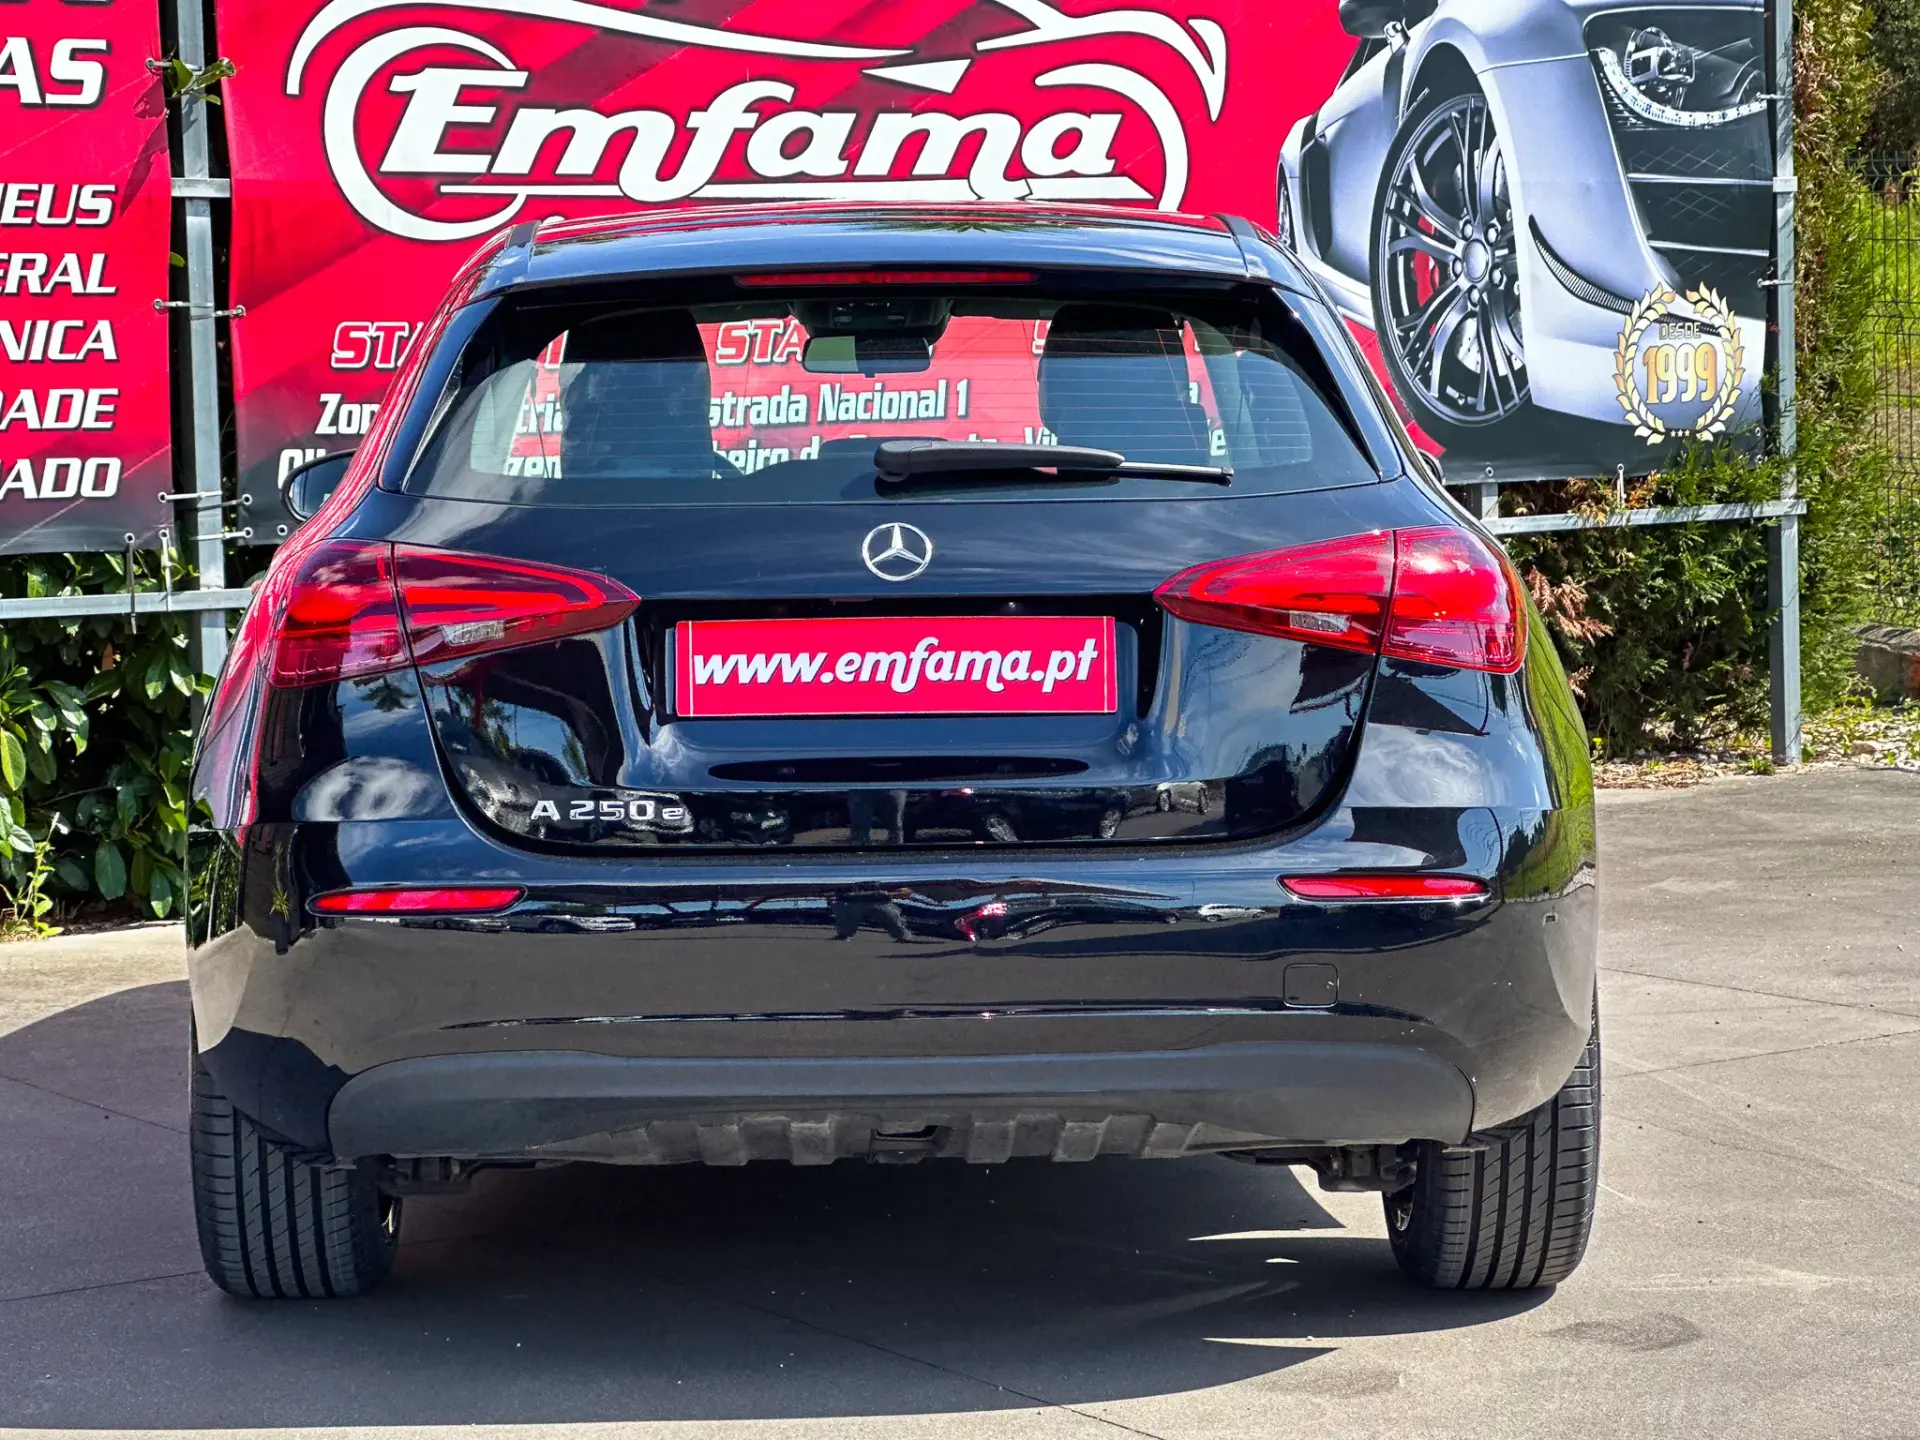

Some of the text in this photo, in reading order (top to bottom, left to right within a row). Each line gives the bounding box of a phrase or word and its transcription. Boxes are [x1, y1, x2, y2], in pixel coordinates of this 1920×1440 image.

[379, 67, 1125, 201] Emfama
[0, 182, 117, 226] EUS
[715, 319, 803, 364] STA
[1659, 322, 1702, 340] DESDE
[1642, 342, 1718, 404] 1999
[0, 387, 120, 430] ADE
[709, 384, 809, 427] strada
[817, 379, 948, 422] Nacional
[956, 378, 969, 417] 1
[0, 457, 122, 500] ADO
[693, 636, 1098, 693] www.emfama.pt
[530, 799, 561, 821] A
